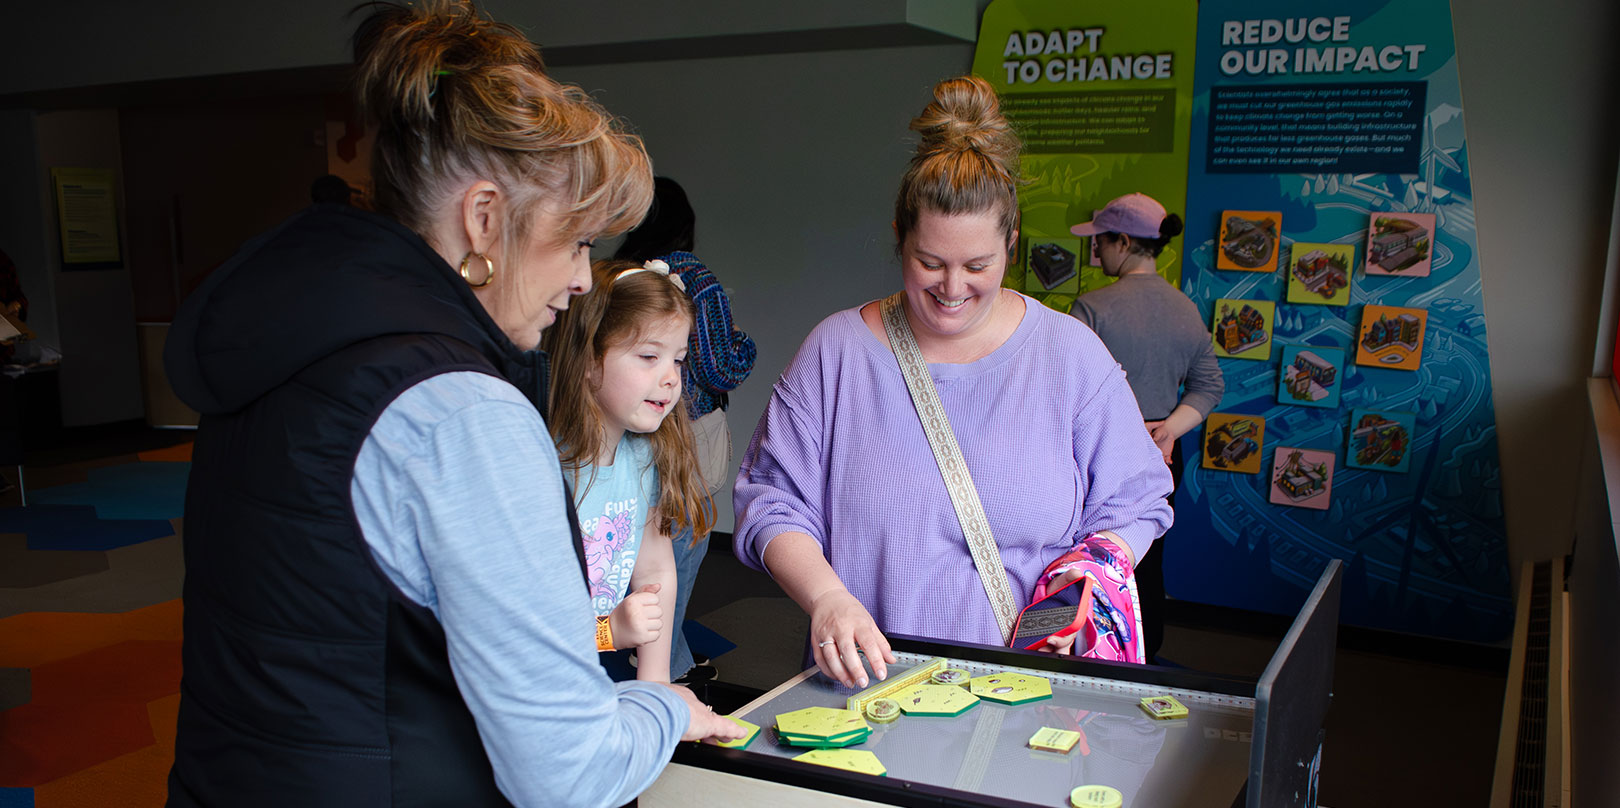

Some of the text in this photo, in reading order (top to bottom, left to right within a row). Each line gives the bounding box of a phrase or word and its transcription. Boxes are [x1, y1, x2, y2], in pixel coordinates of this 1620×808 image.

[1221, 16, 1351, 47] REDUCE
[1004, 28, 1104, 57] ADAPT
[1220, 45, 1427, 77] OUR IMPACT
[1003, 55, 1172, 85] TO CHANGE
[1218, 90, 1253, 99] Scientists
[1254, 89, 1316, 100] overwhelmingly
[1317, 89, 1340, 98] agree
[1342, 88, 1359, 96] that
[1379, 87, 1411, 97] society,
[1277, 101, 1324, 110] greenhouse
[1325, 101, 1340, 109] gas
[1341, 99, 1382, 107] emissions
[1383, 98, 1413, 108] rapidly
[1224, 113, 1244, 122] keep
[1244, 112, 1273, 120] climate
[1274, 112, 1304, 121] change
[1305, 111, 1325, 119] from
[1326, 111, 1354, 121] getting
[1356, 111, 1382, 119] worse.
[1383, 110, 1396, 118] On
[1215, 123, 1258, 133] community
[1280, 122, 1297, 131] that
[1327, 122, 1360, 132] building
[1361, 121, 1417, 130] infrastructure
[1231, 135, 1267, 144] produces
[1280, 134, 1295, 142] less
[1296, 133, 1343, 144] greenhouse
[1371, 133, 1386, 141] But
[1387, 133, 1412, 141] much
[1213, 145, 1222, 153] of
[1222, 145, 1235, 153] the
[1236, 145, 1279, 155] technology
[1292, 145, 1313, 153] need
[1313, 144, 1345, 155] already
[1309, 156, 1338, 167] region!
